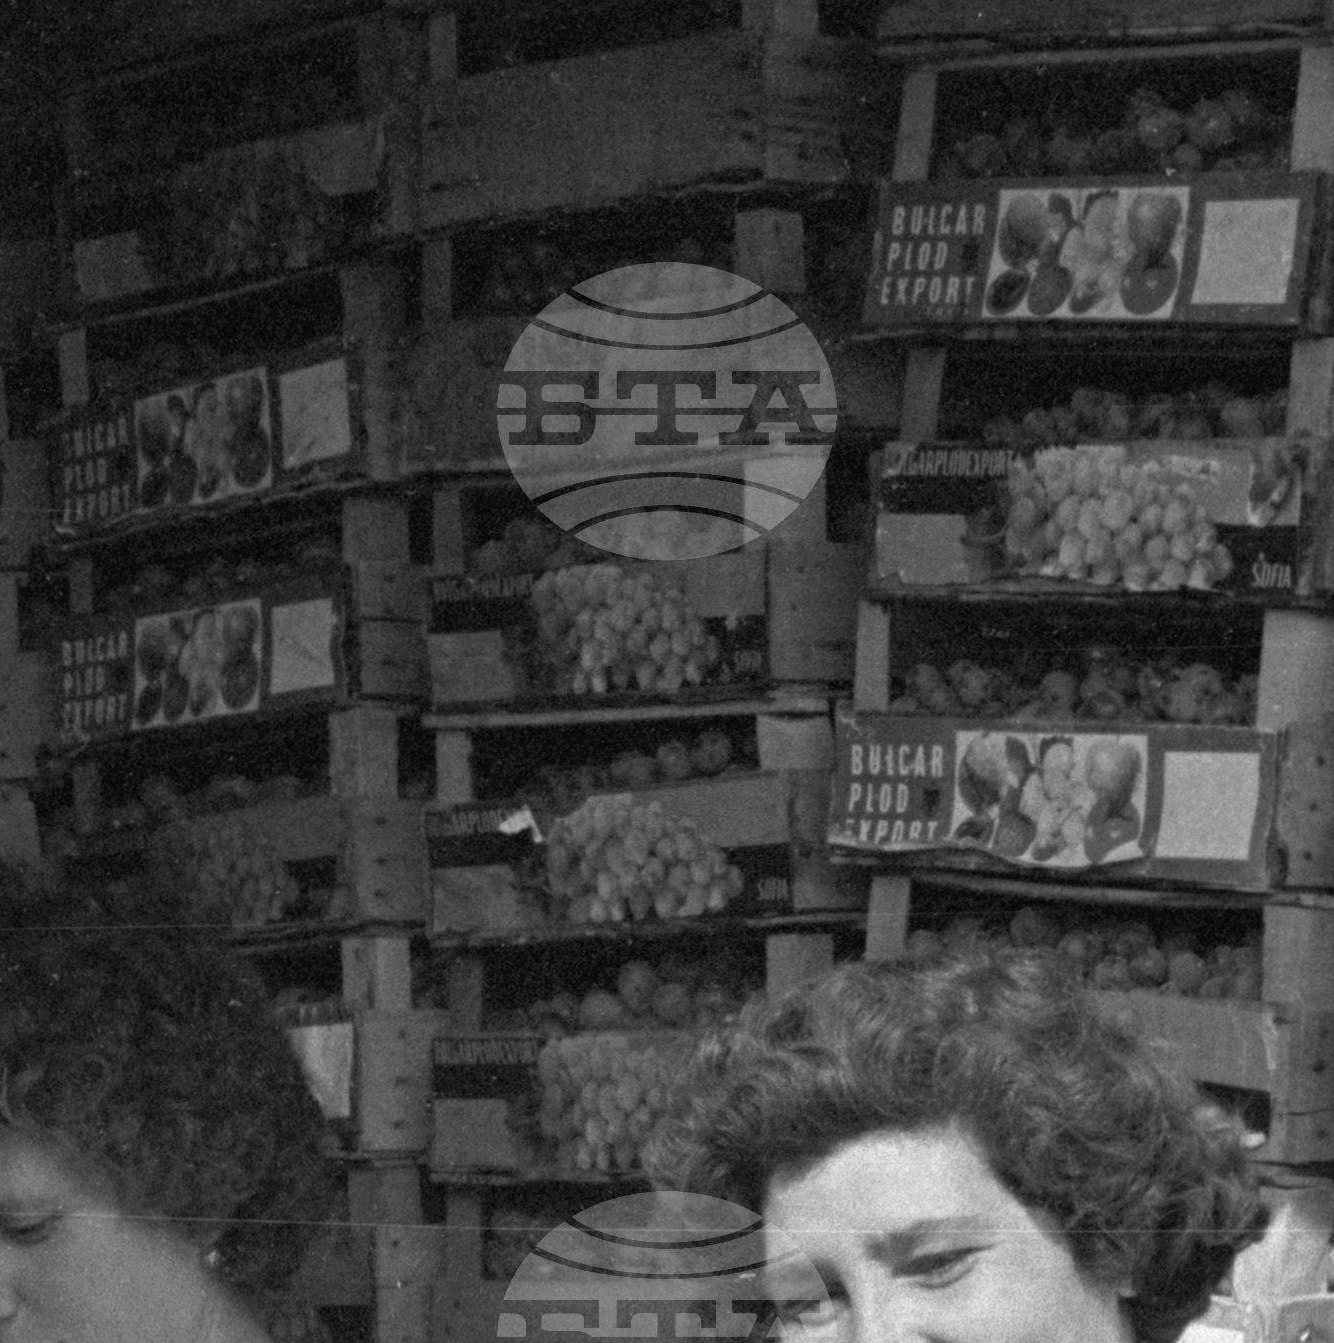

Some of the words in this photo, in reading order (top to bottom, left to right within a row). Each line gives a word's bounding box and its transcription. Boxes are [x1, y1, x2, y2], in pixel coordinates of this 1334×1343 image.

[885, 239, 949, 273] PLOD
[878, 273, 976, 307] EXPORT
[846, 781, 910, 815] PLOD
